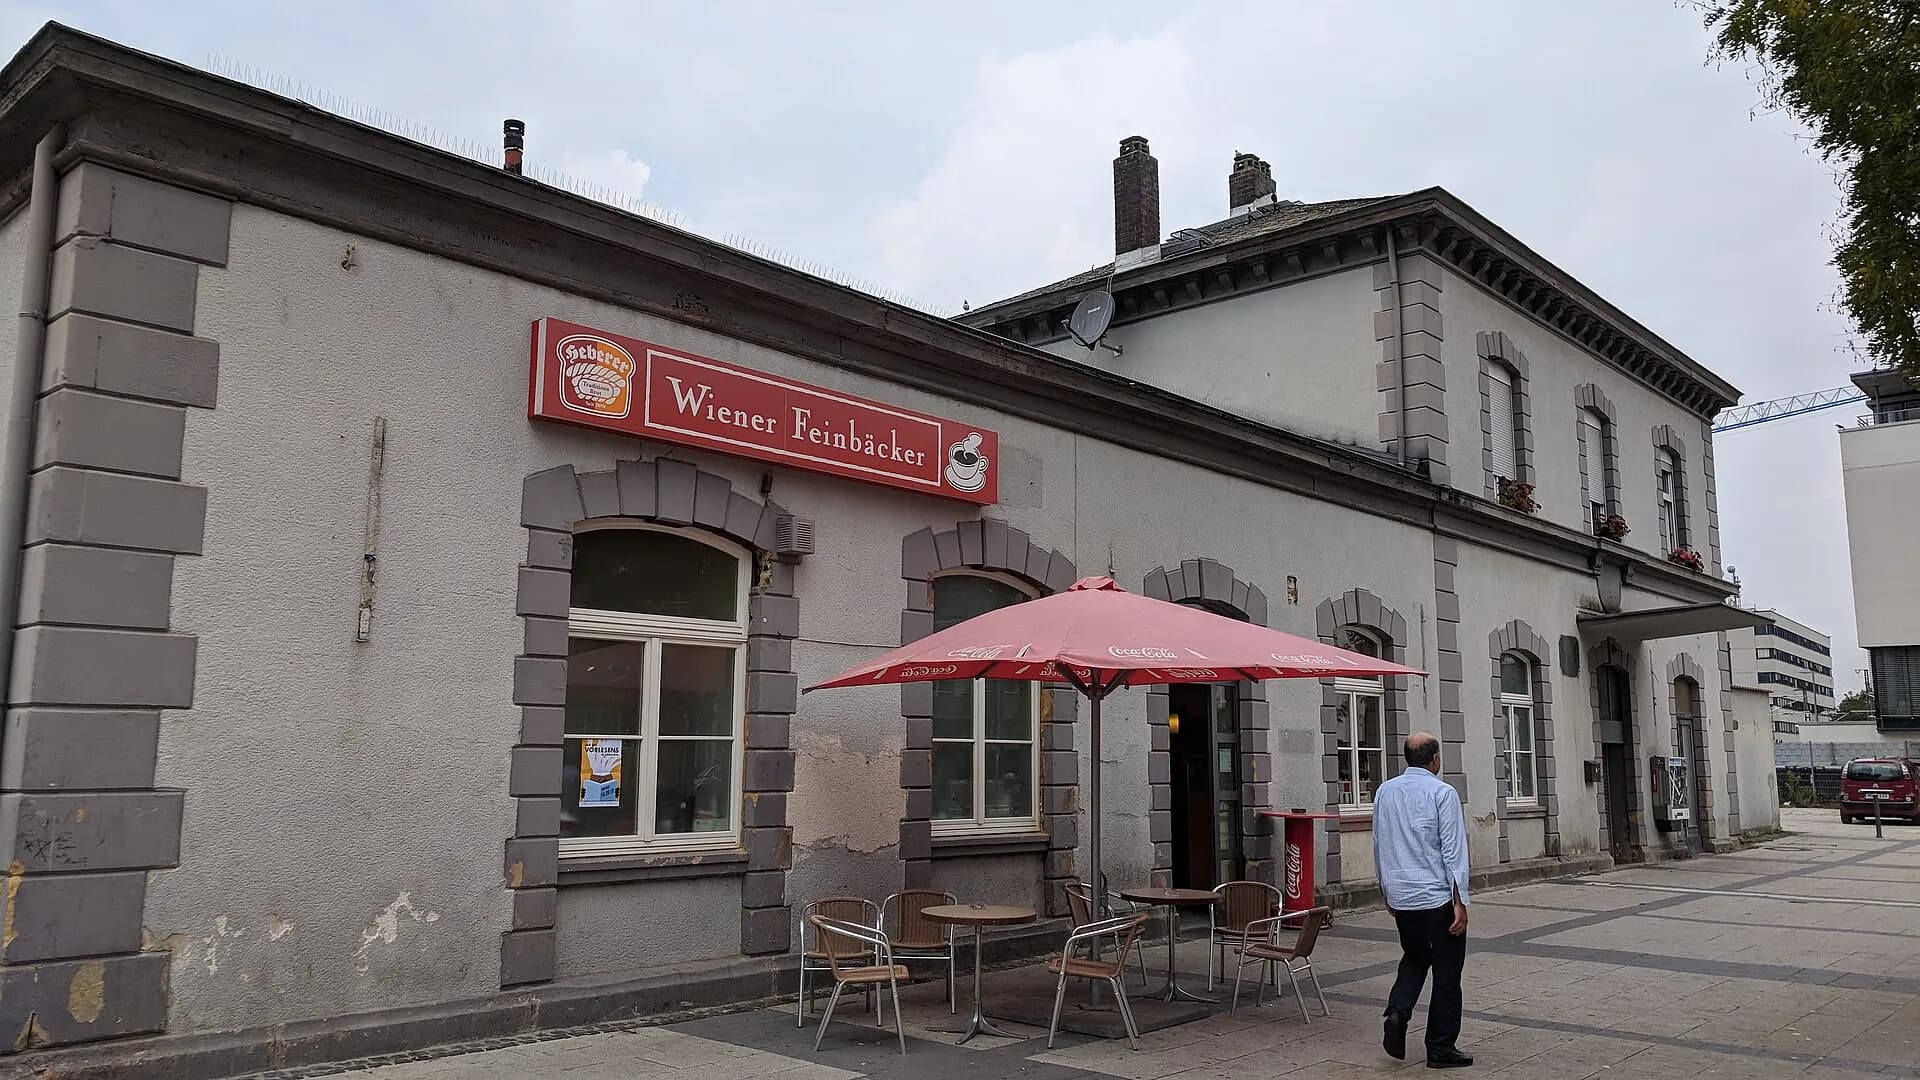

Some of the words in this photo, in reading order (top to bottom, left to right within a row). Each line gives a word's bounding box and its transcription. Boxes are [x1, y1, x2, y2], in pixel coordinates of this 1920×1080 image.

[565, 344, 629, 373] Heberer
[665, 375, 777, 434] Wiener
[791, 406, 925, 466] Feinbäcker
